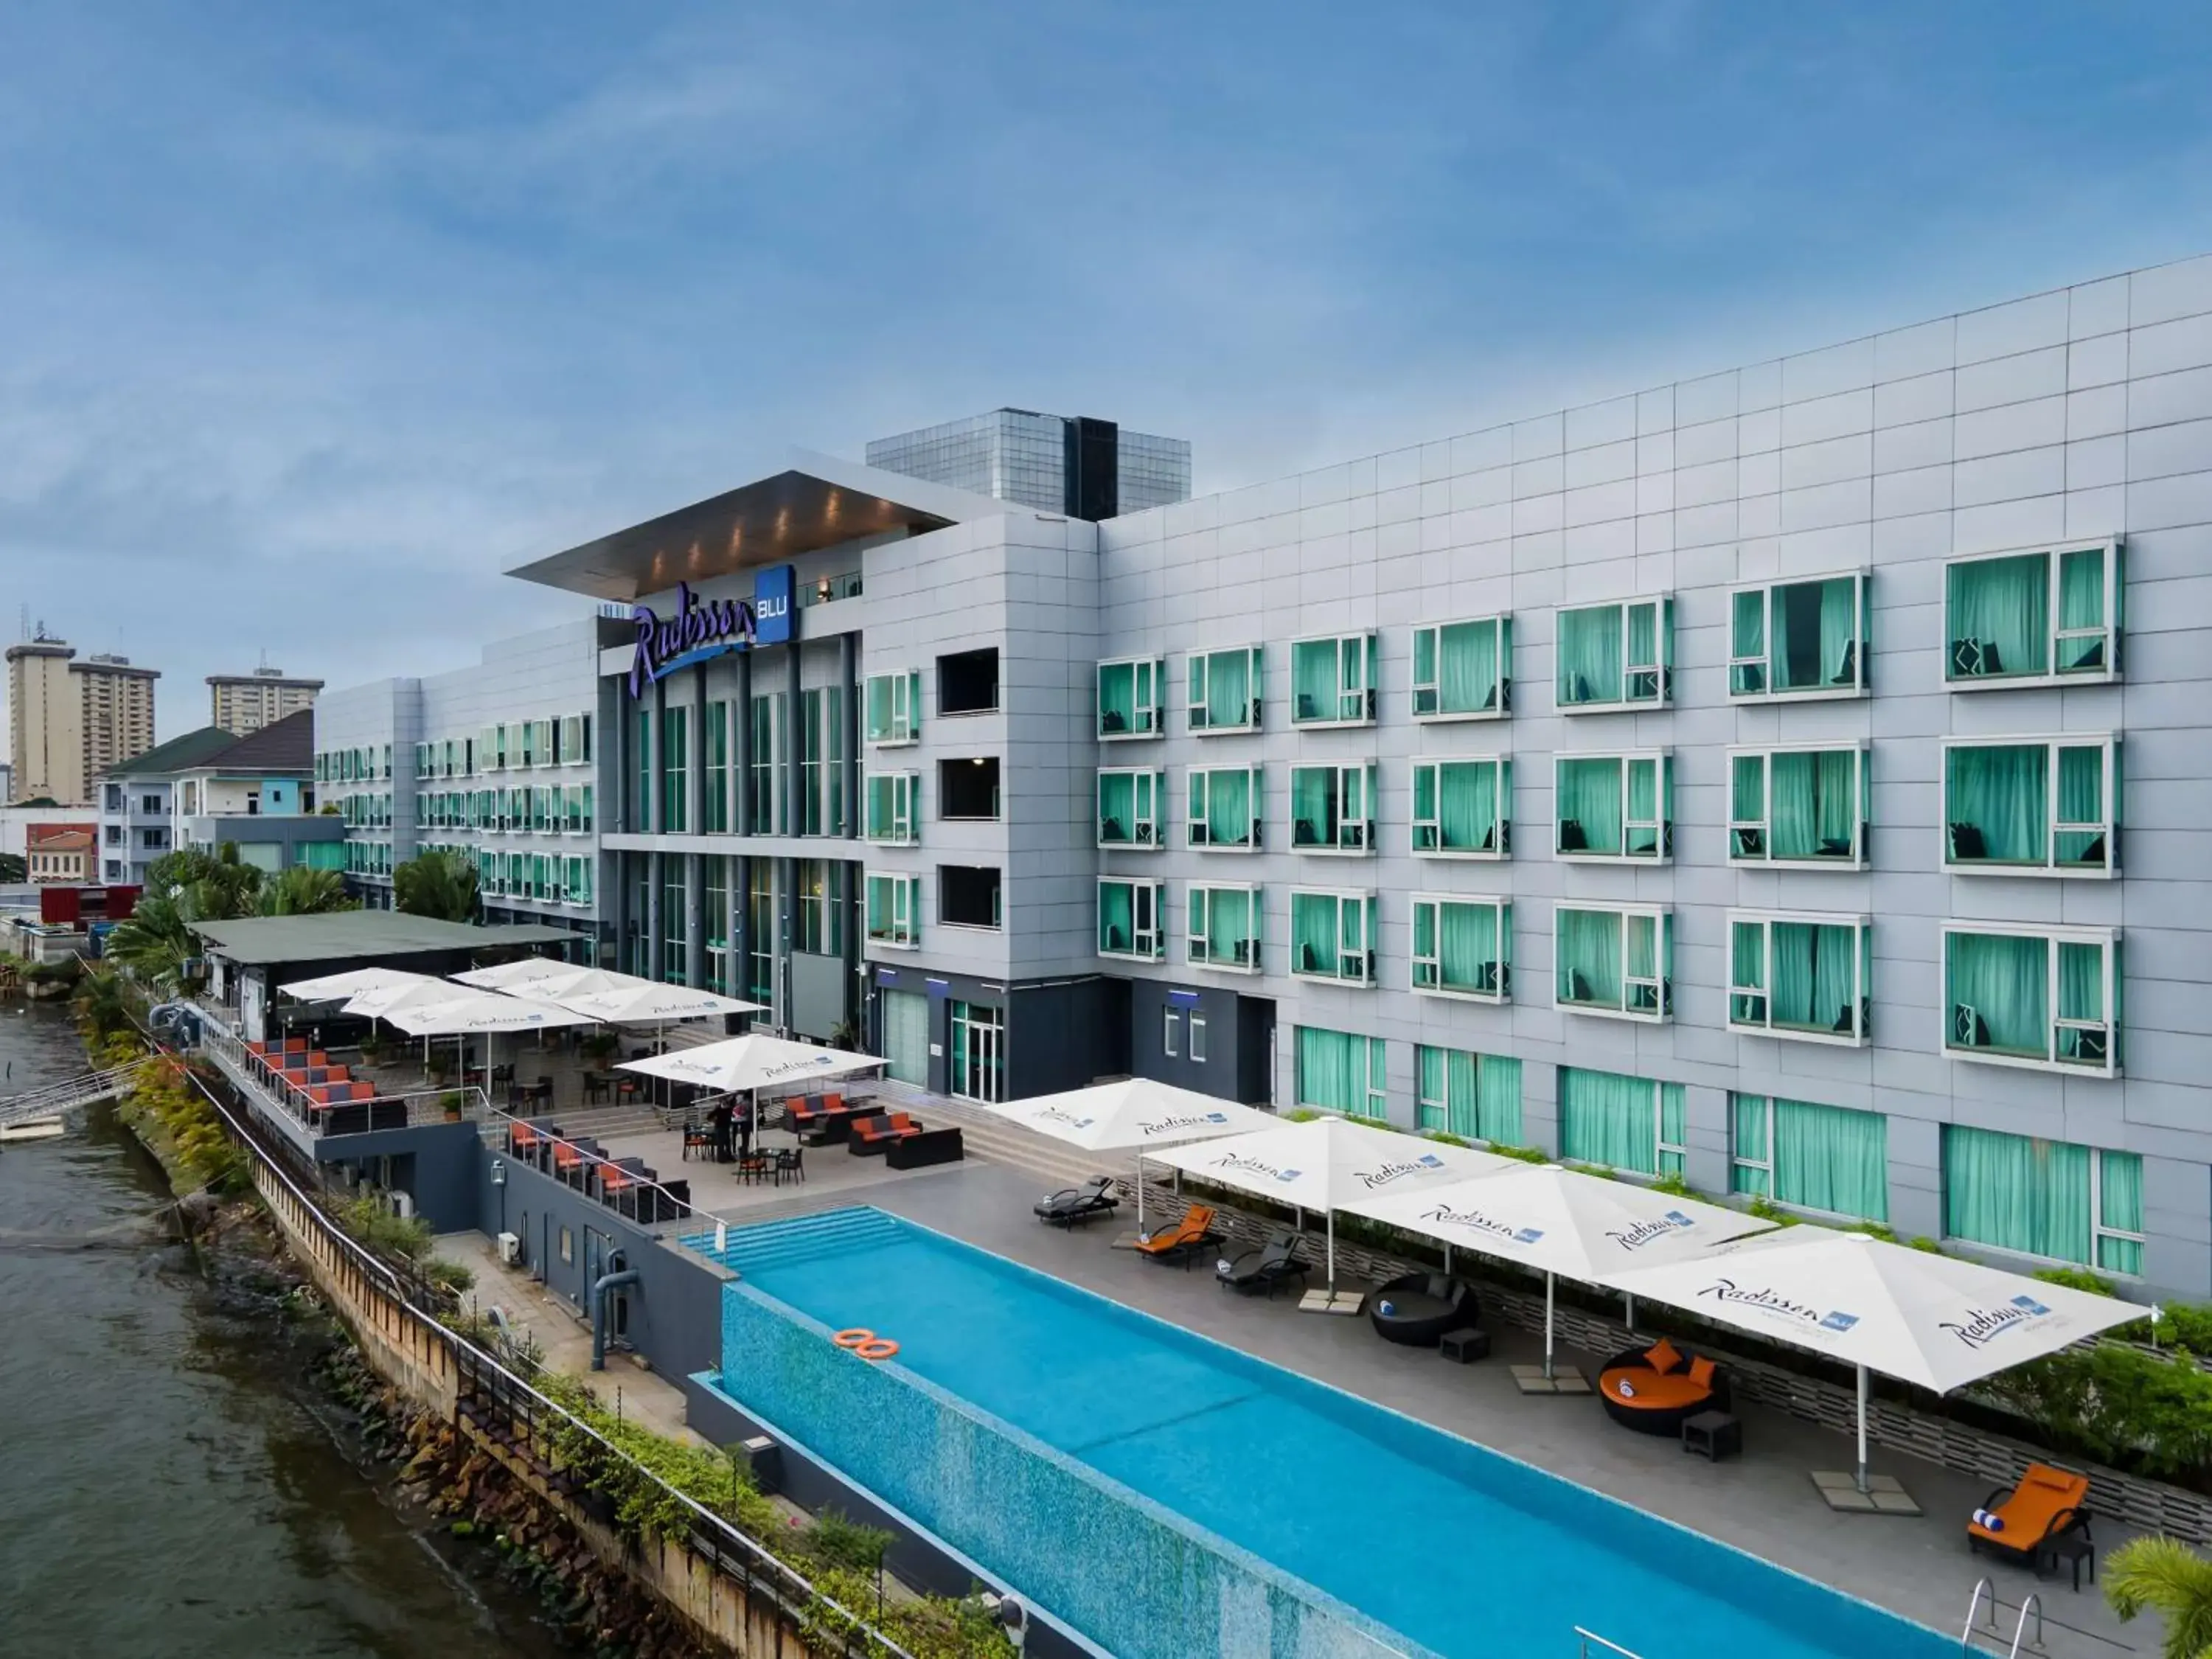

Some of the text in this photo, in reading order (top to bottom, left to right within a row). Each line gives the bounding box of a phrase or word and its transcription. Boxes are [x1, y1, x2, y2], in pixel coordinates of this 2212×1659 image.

[629, 580, 787, 700] Radisson BLU
[1605, 1222, 1678, 1251] Radisson
[1697, 1279, 1818, 1321] Radisson
[1938, 1301, 2031, 1349] Radisson
